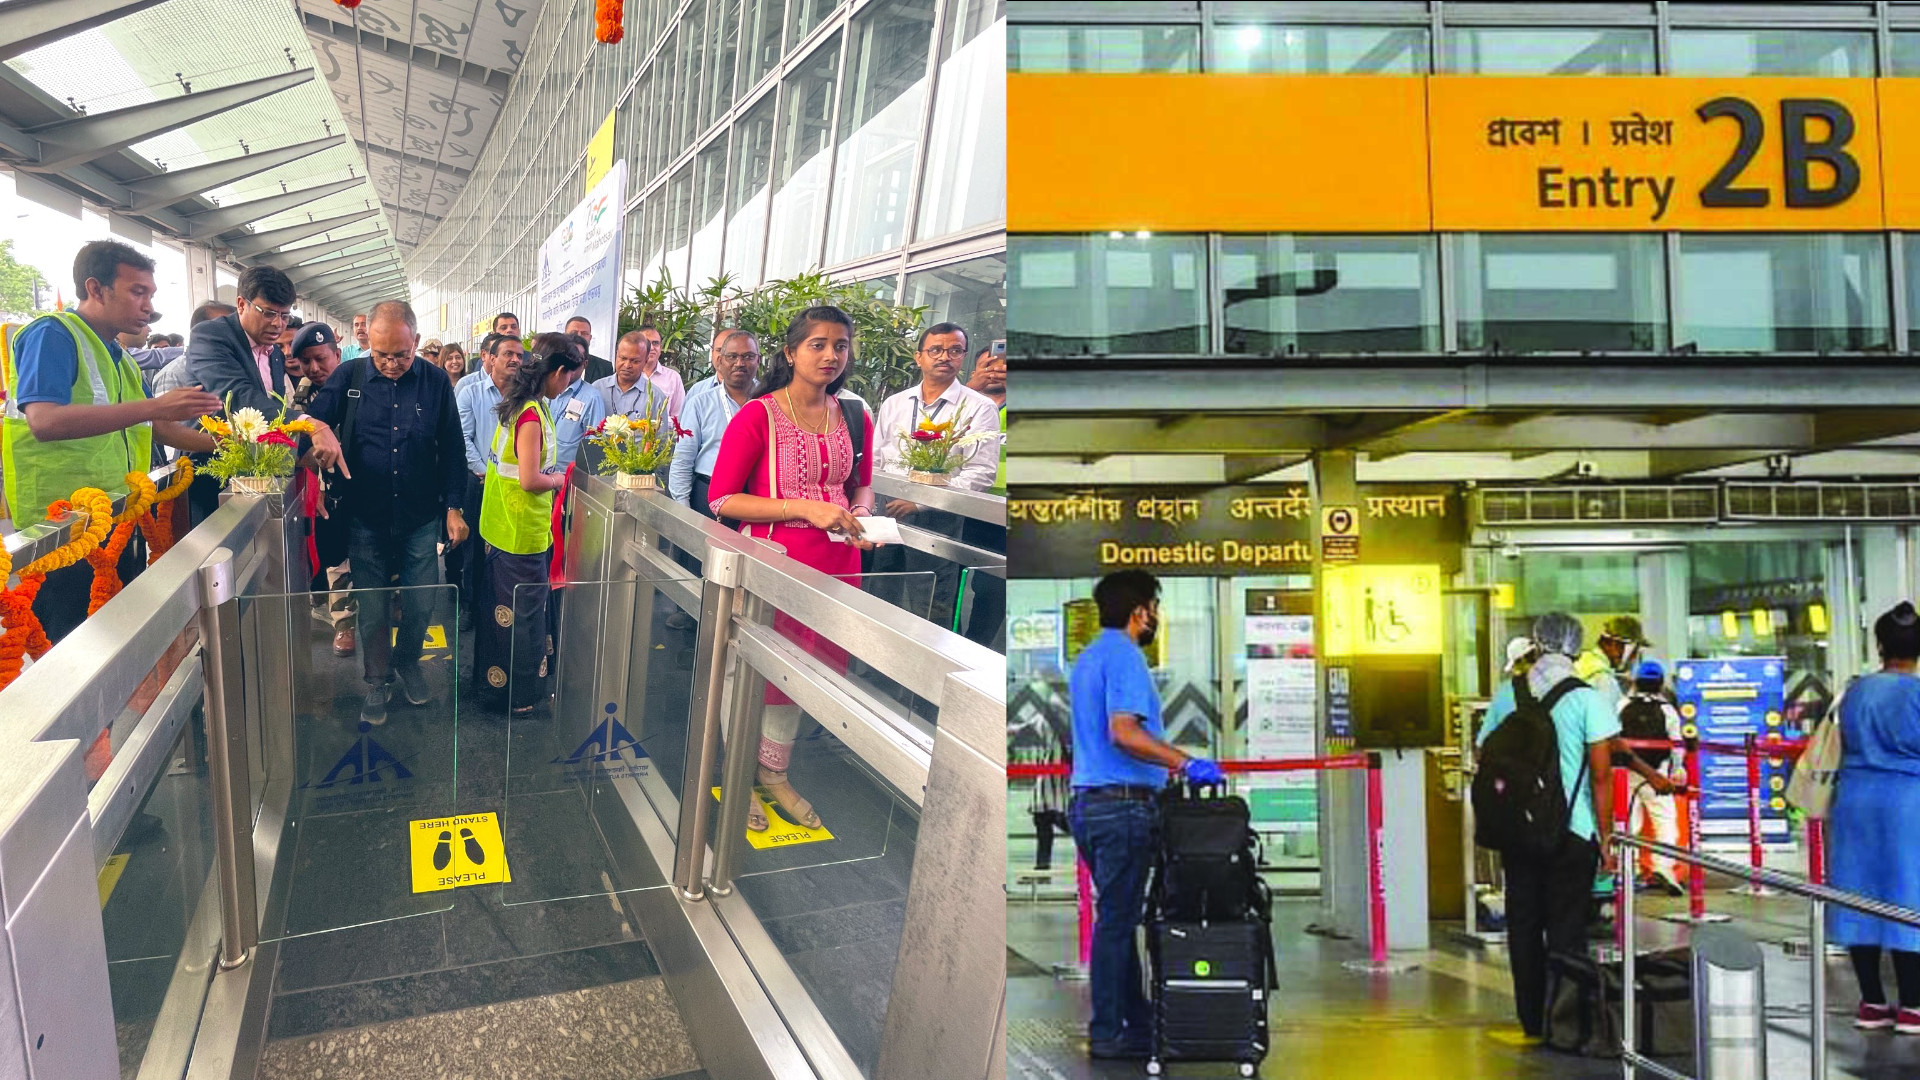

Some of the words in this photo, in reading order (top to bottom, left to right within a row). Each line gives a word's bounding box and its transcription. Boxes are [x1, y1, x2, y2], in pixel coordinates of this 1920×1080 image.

[1487, 117, 1562, 147] প্রবেশ
[1609, 112, 1674, 146] प्रवेश
[1694, 97, 1861, 208] 2B
[1537, 166, 1676, 222] Entry
[1366, 495, 1446, 518] प्रस्थान
[1100, 541, 1216, 565] Domestic
[1223, 540, 1313, 567] Departu
[419, 820, 449, 830] HERE
[453, 816, 488, 826] STAND
[769, 831, 811, 842] PLEASE
[438, 873, 486, 885] PLEASE
